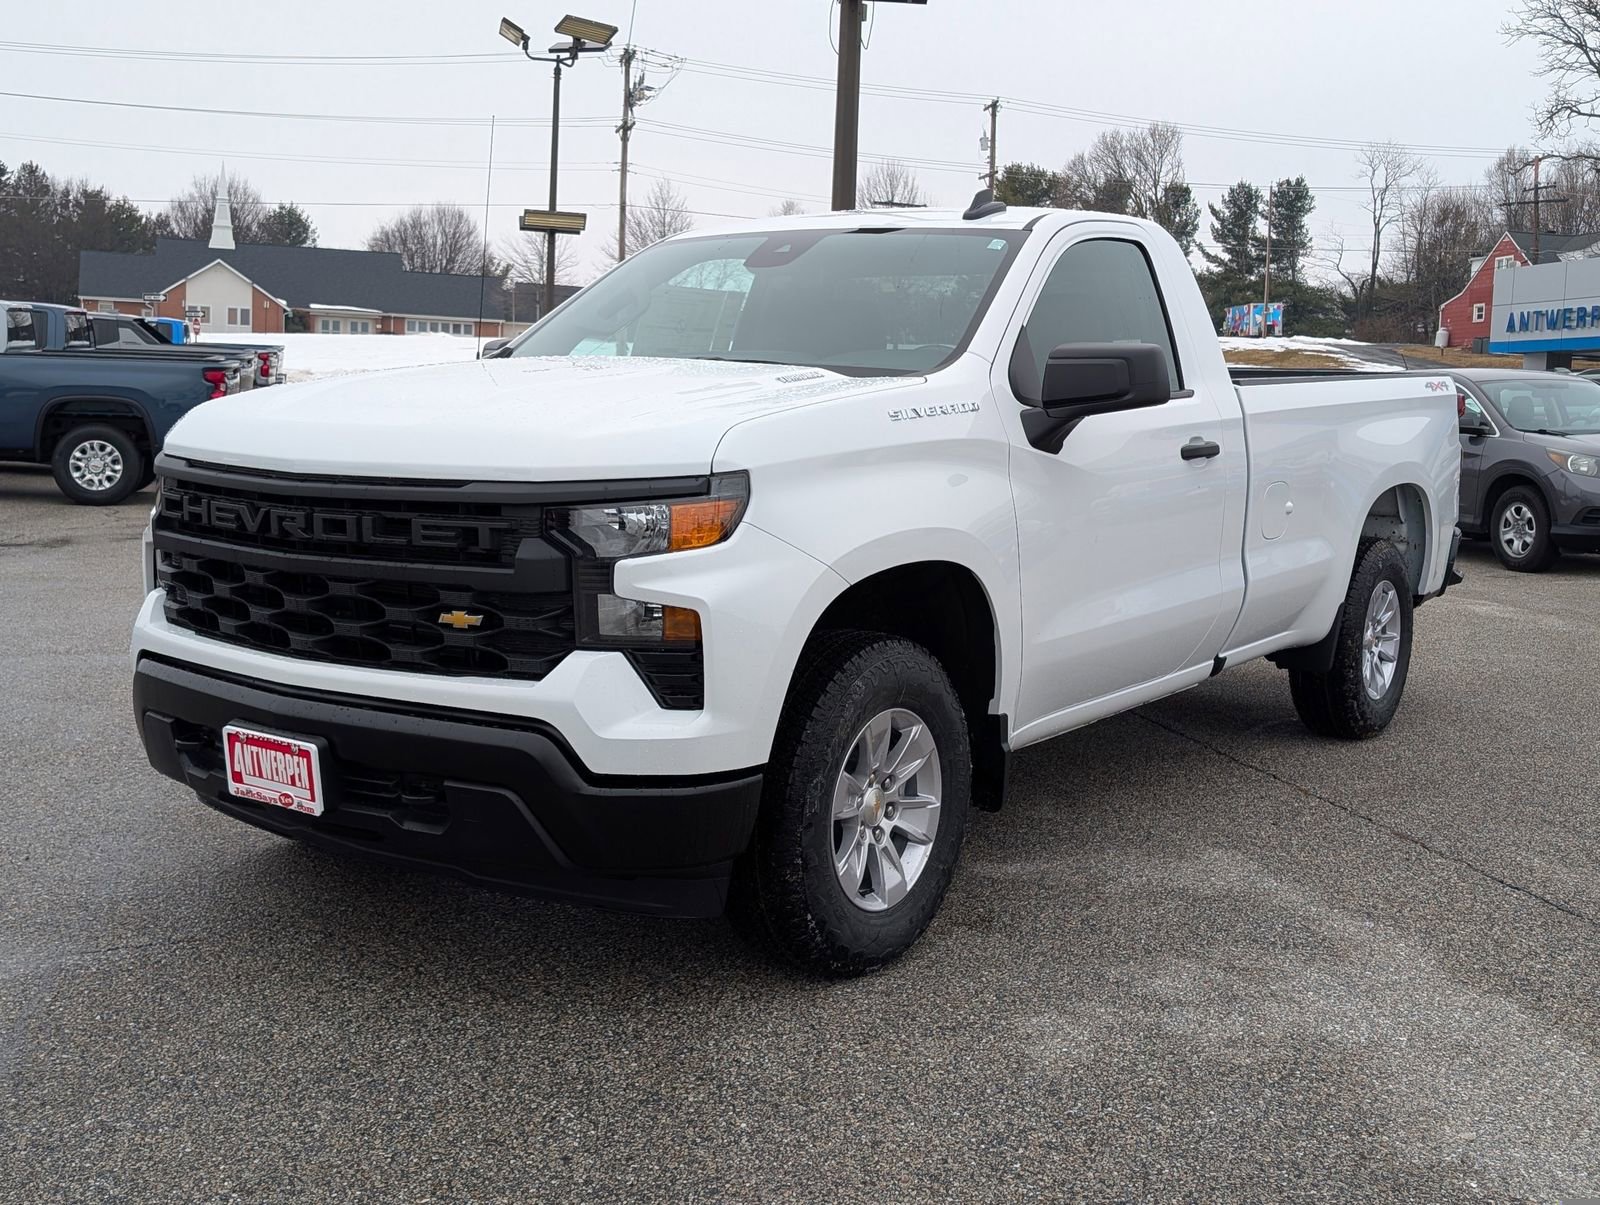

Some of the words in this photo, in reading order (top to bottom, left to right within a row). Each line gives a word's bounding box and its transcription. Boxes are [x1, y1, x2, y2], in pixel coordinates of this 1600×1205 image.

[888, 402, 980, 421] SILVERADO
[161, 491, 515, 549] CHEVROLET
[233, 742, 310, 791] ANTWERPEN
